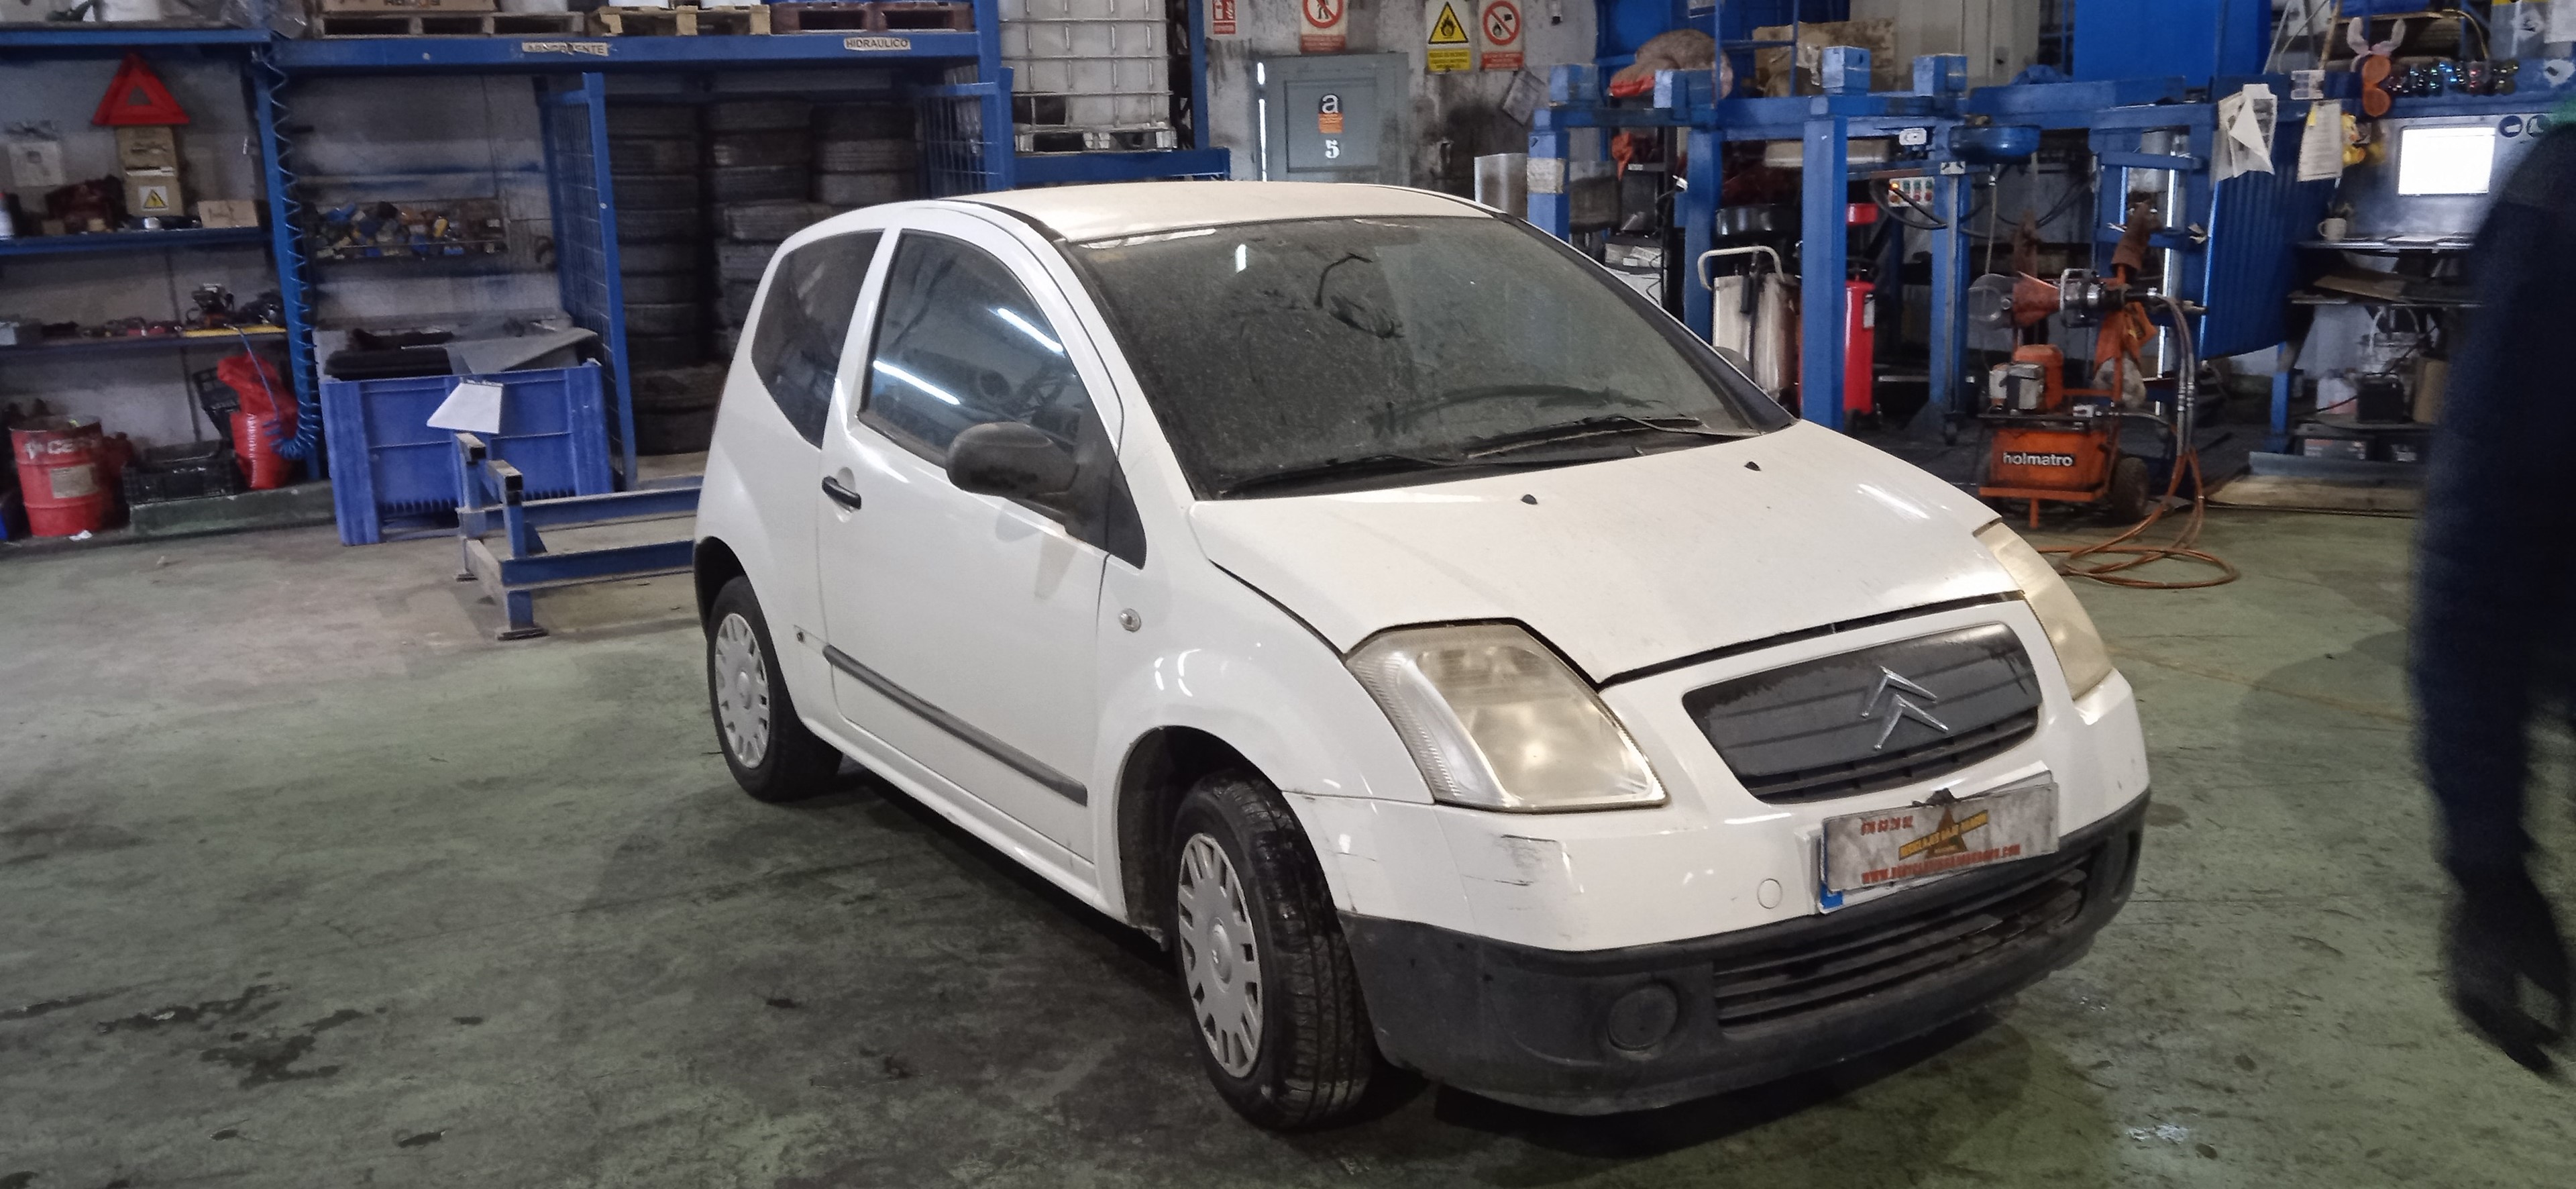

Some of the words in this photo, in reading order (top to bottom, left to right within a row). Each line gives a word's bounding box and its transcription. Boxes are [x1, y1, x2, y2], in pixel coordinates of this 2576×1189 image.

[847, 39, 908, 48] HIDRAULICO
[1326, 140, 1340, 158] 5
[2003, 452, 2073, 466] holmatro
